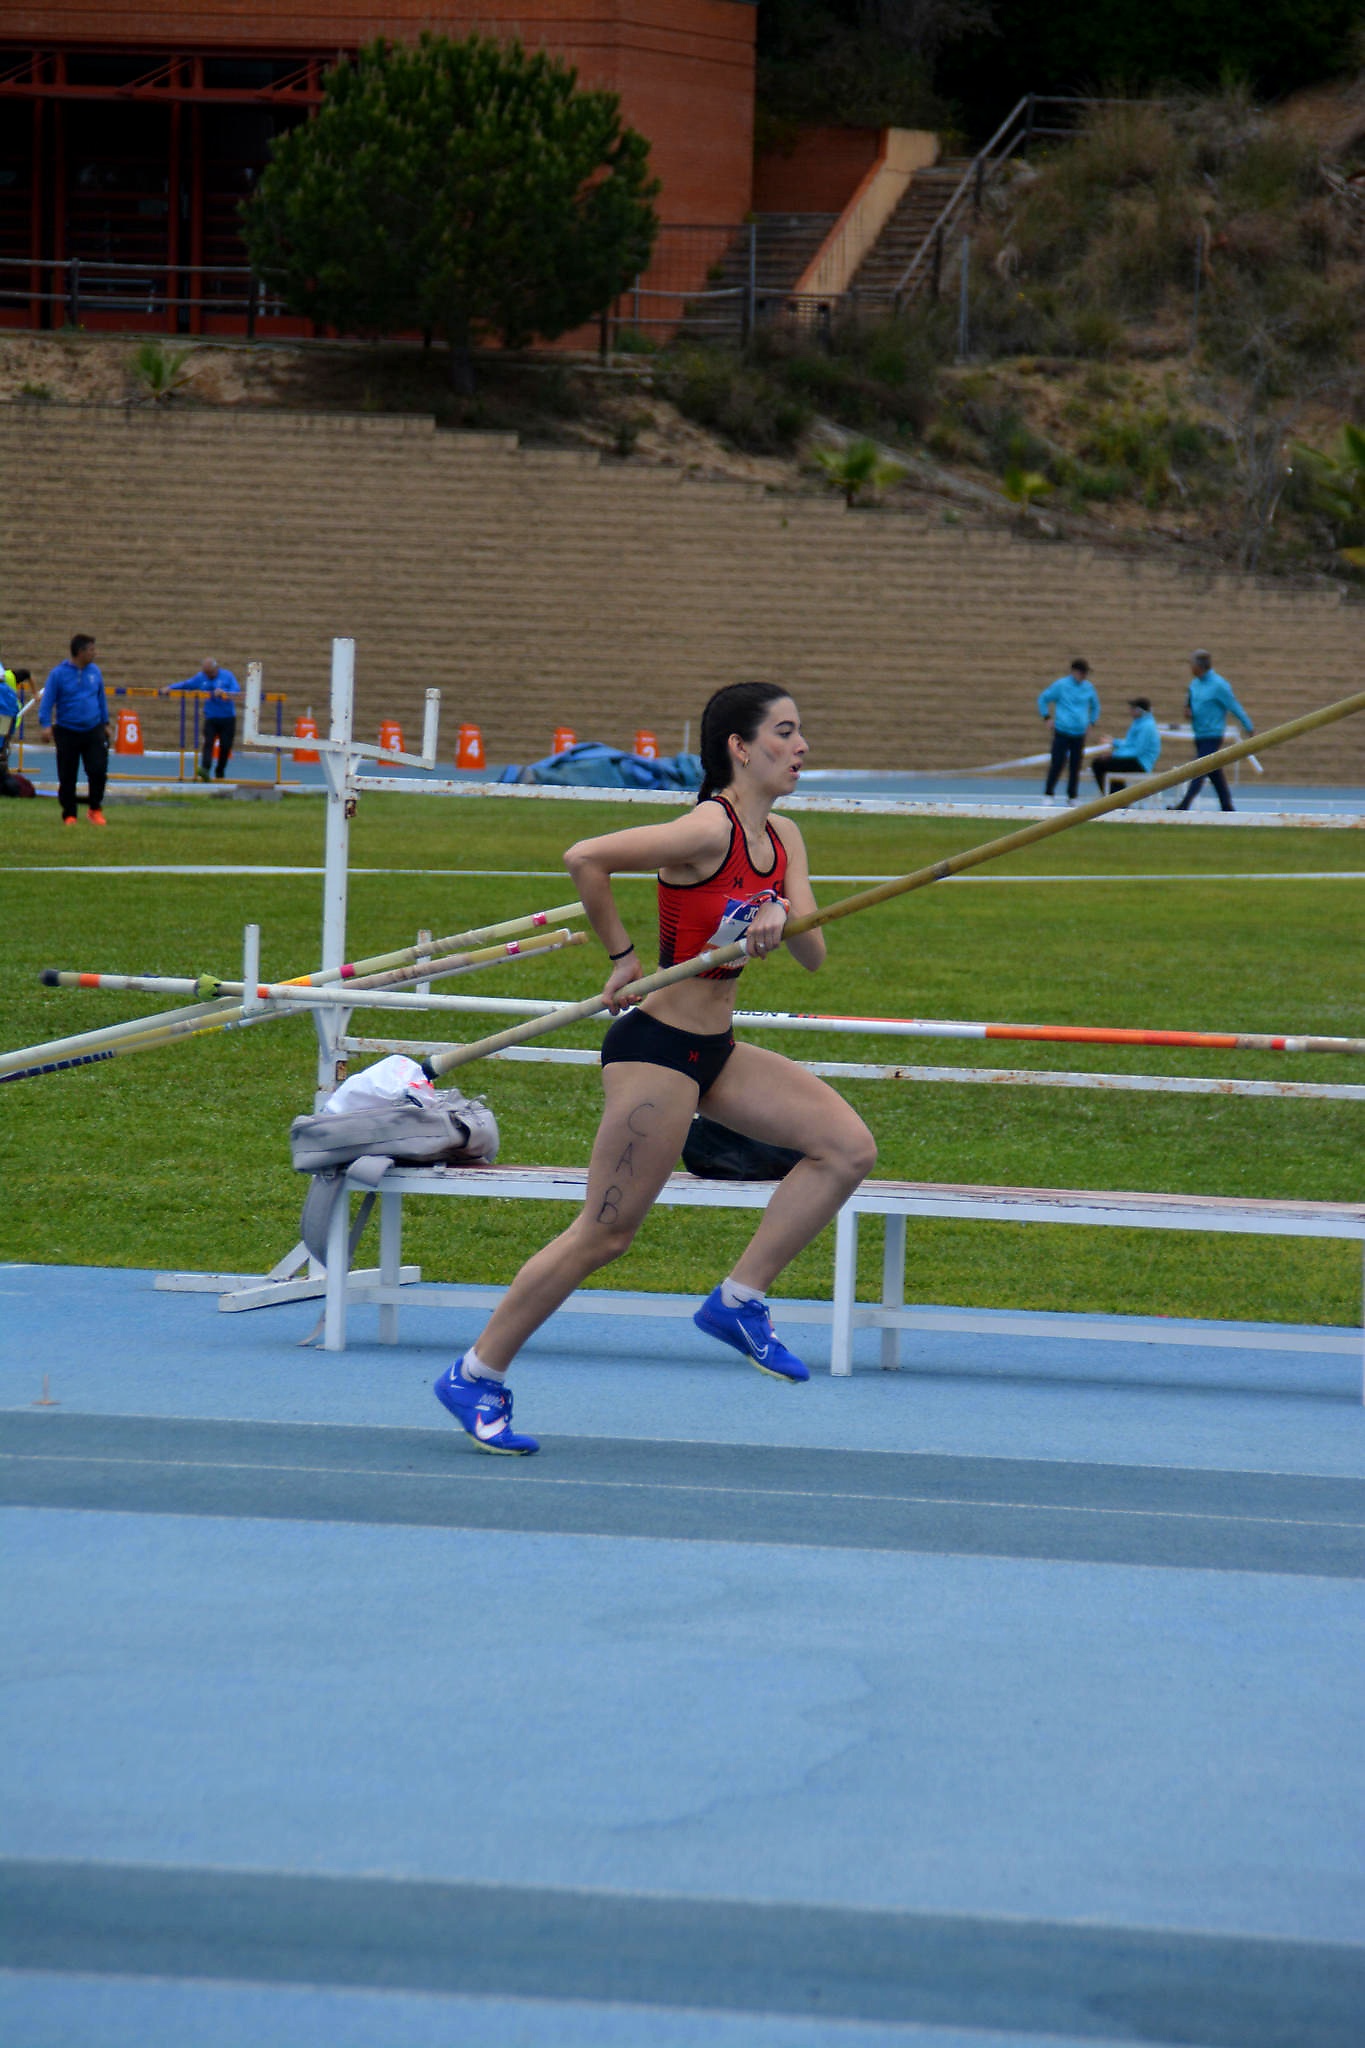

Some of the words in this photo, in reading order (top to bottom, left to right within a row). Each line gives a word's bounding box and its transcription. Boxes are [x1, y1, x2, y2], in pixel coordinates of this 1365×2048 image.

[126, 723, 138, 743] 8
[390, 735, 401, 753] 5
[467, 739, 479, 758] 4
